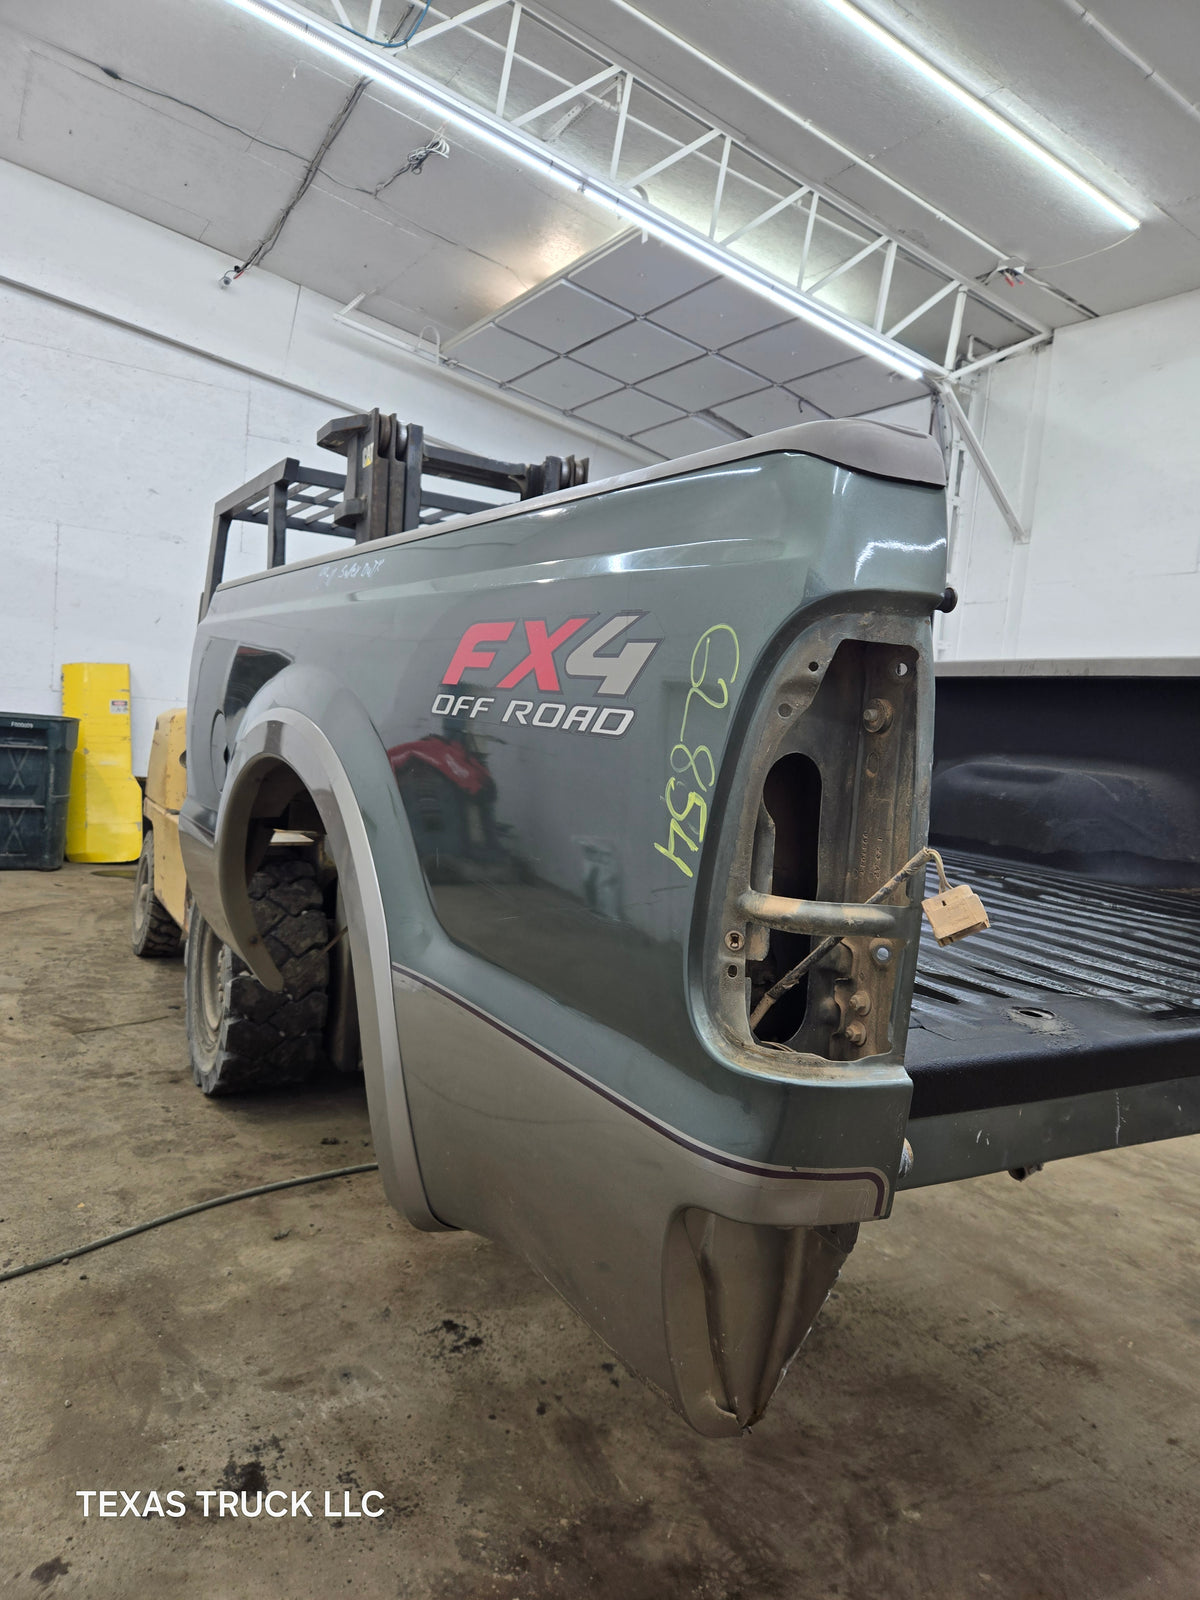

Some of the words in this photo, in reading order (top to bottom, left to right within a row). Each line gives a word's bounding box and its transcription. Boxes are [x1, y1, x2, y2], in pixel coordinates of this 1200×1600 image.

[440, 612, 660, 697] FX4
[431, 694, 495, 718] OFF
[501, 700, 635, 736] ROAD
